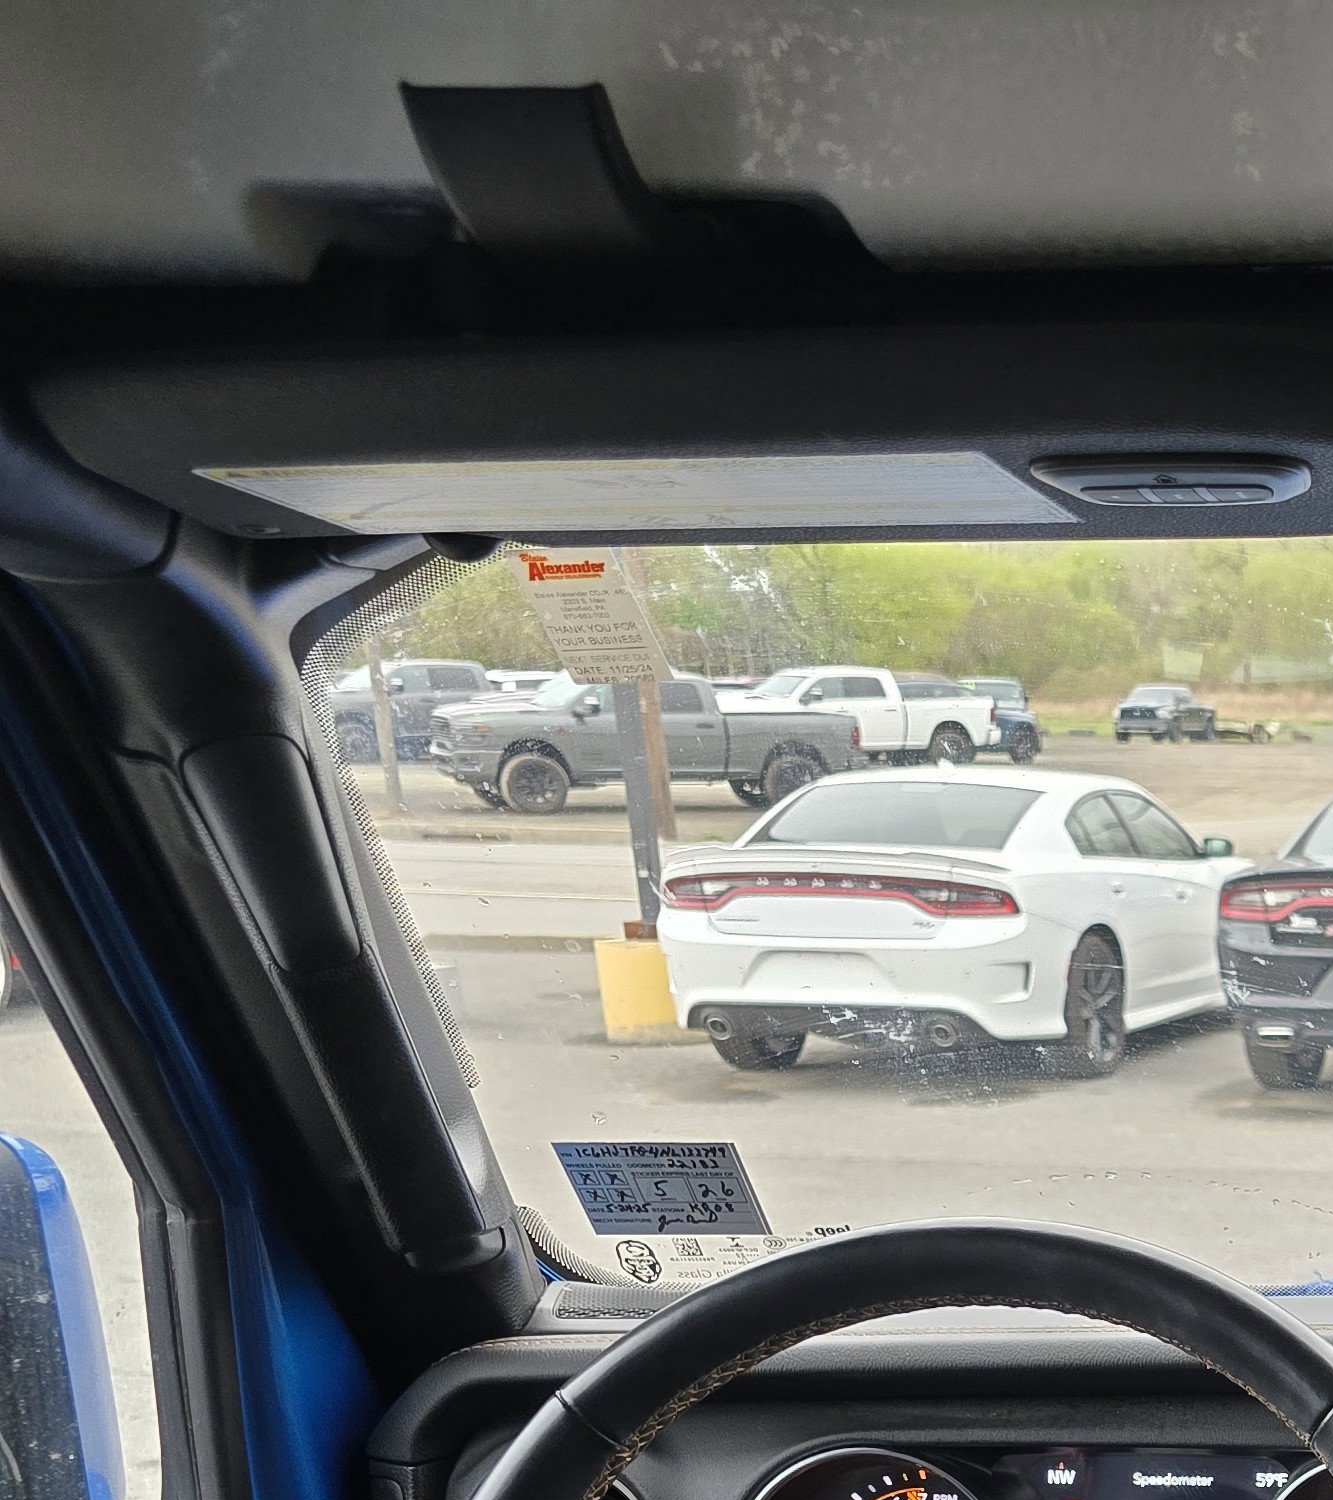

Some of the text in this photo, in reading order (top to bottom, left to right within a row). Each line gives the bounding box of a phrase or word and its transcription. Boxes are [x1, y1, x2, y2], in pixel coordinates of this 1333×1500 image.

[529, 560, 605, 581] Alexander
[547, 621, 637, 634] THANK YOU FOR
[555, 634, 643, 646] YOUR BUSINESS
[654, 1180, 668, 1197] 5
[1047, 1469, 1076, 1485] NW
[1132, 1472, 1214, 1488] Speedometer
